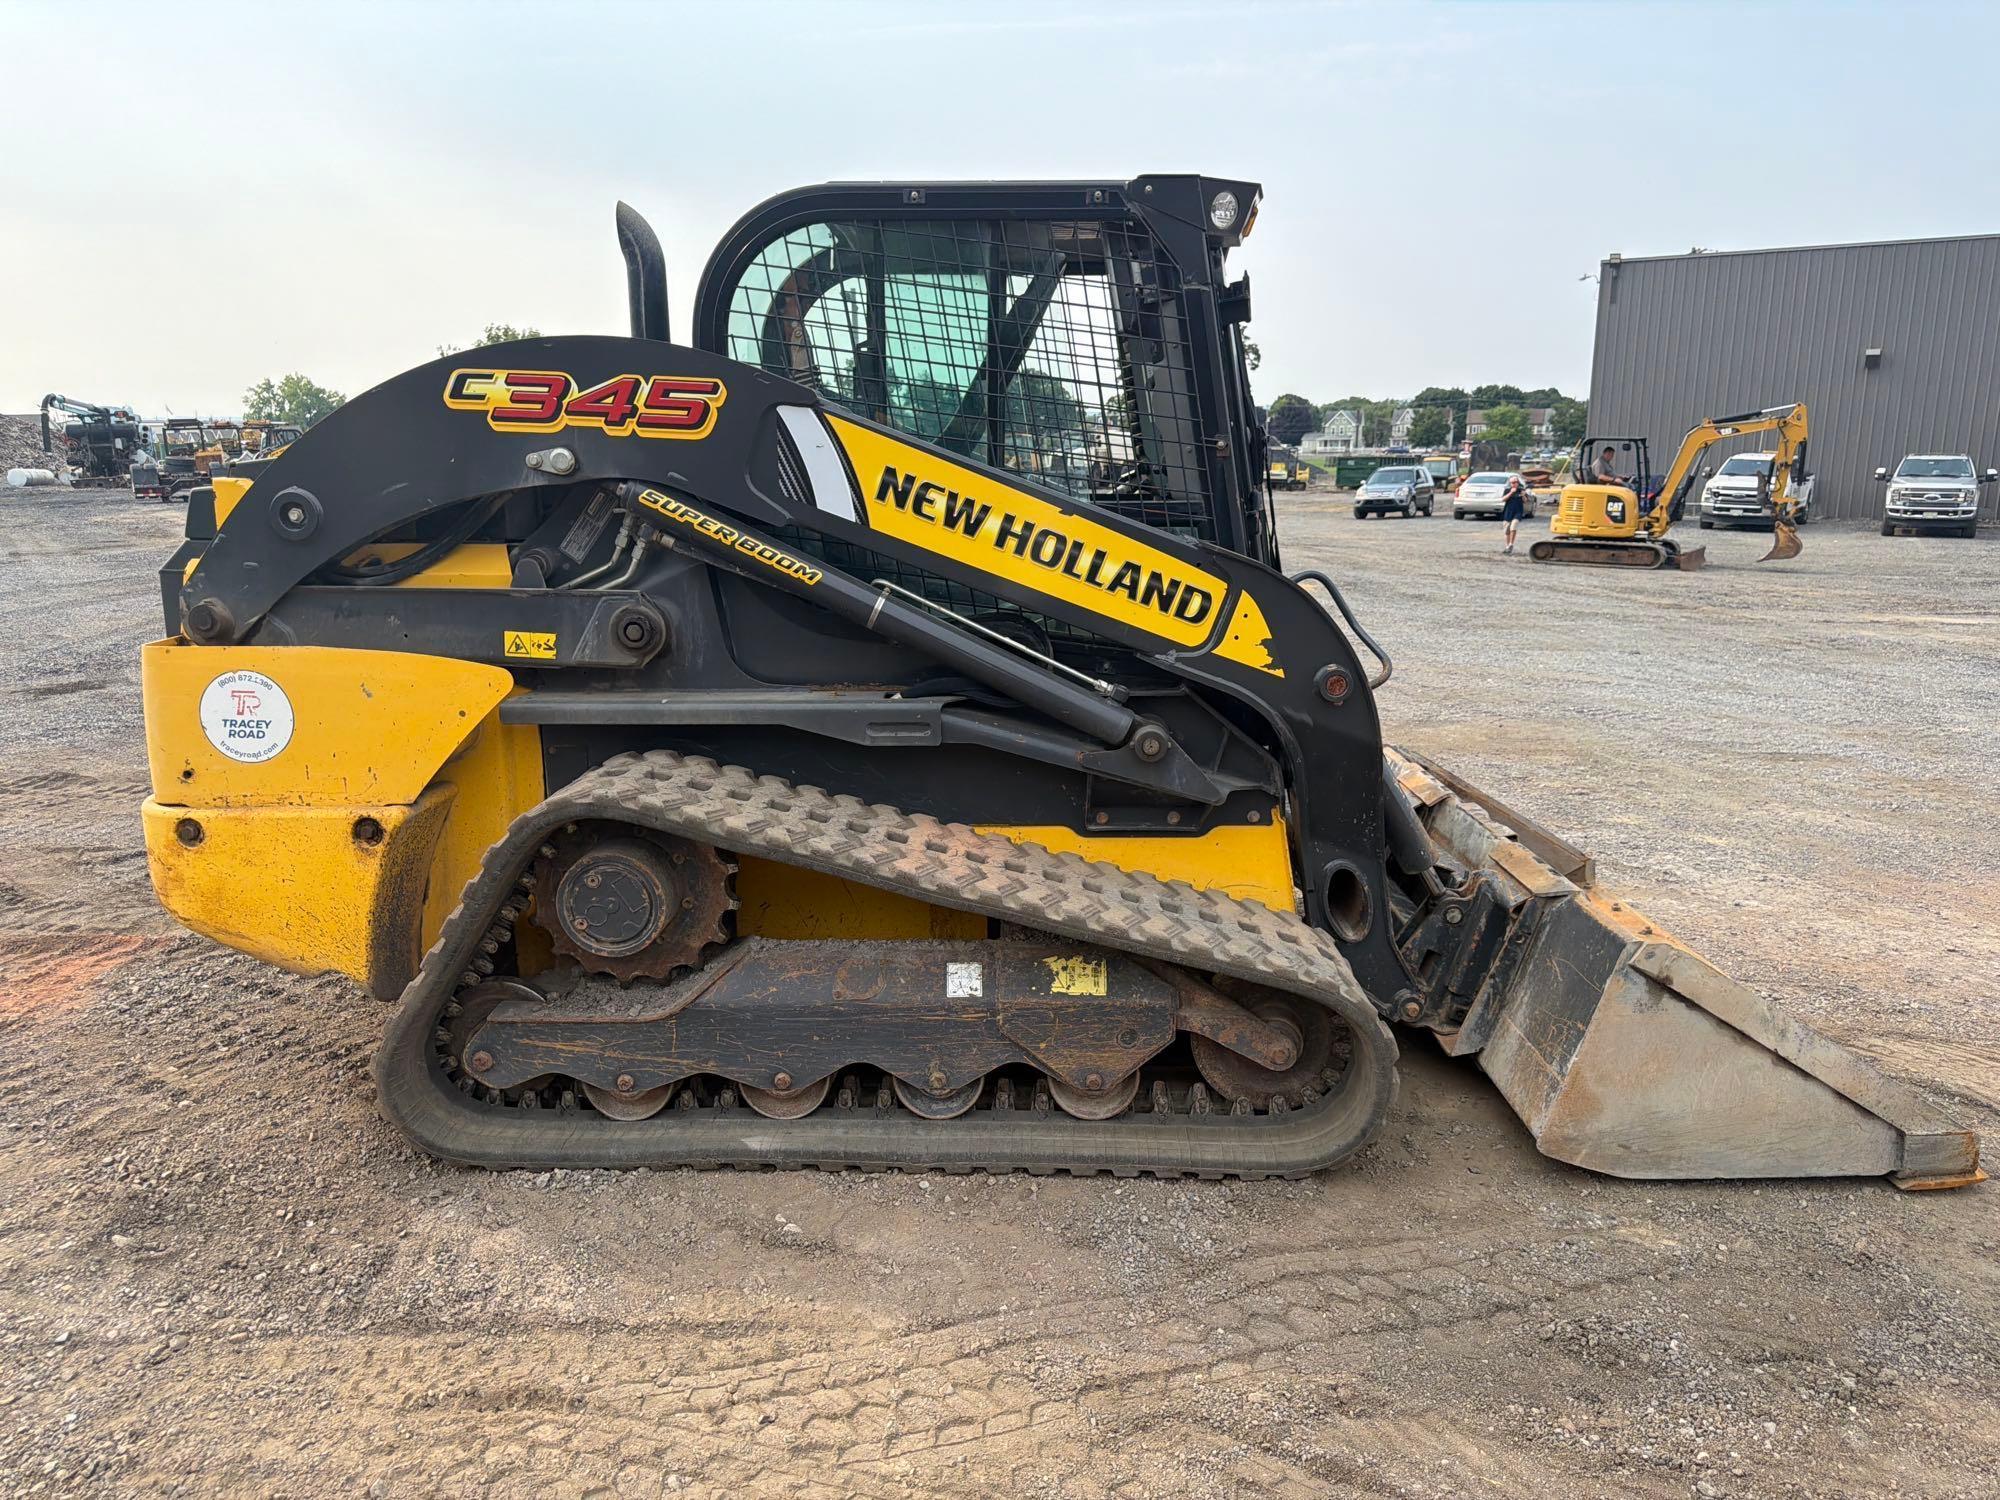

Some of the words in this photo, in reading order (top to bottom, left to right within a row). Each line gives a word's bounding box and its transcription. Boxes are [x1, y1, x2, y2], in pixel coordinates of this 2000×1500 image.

[1607, 501, 1623, 512] CAT
[874, 465, 992, 539] NEW
[993, 512, 1214, 626] HOLLAND
[217, 675, 237, 689] (800)
[222, 718, 272, 730] TRACEY
[228, 729, 266, 740] ROAD
[219, 740, 279, 759] traceyroad.com
